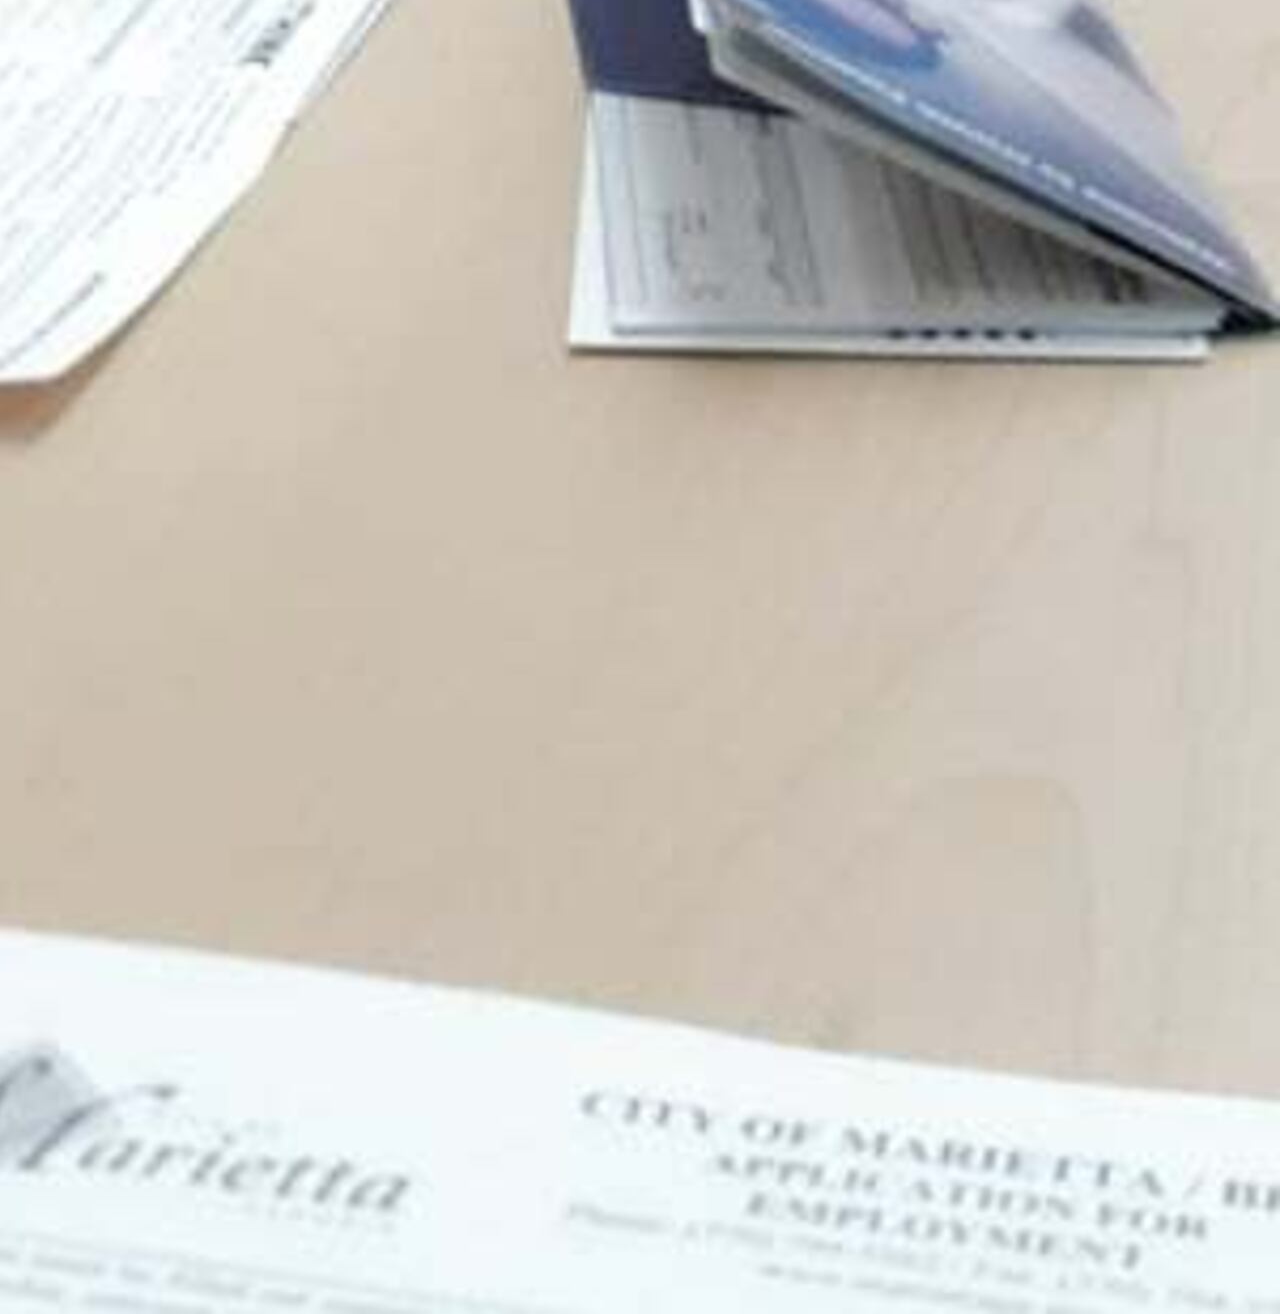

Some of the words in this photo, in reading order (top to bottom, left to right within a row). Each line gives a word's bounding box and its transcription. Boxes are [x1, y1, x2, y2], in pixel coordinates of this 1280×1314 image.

[580, 1088, 715, 1136] CITY
[739, 1113, 817, 1148] OF
[841, 1126, 1167, 1200] MARIETTA
[714, 1150, 1080, 1222] APPLICATION
[1096, 1200, 1210, 1242] FOR
[746, 1191, 1142, 1272] EMPLOYMENT
